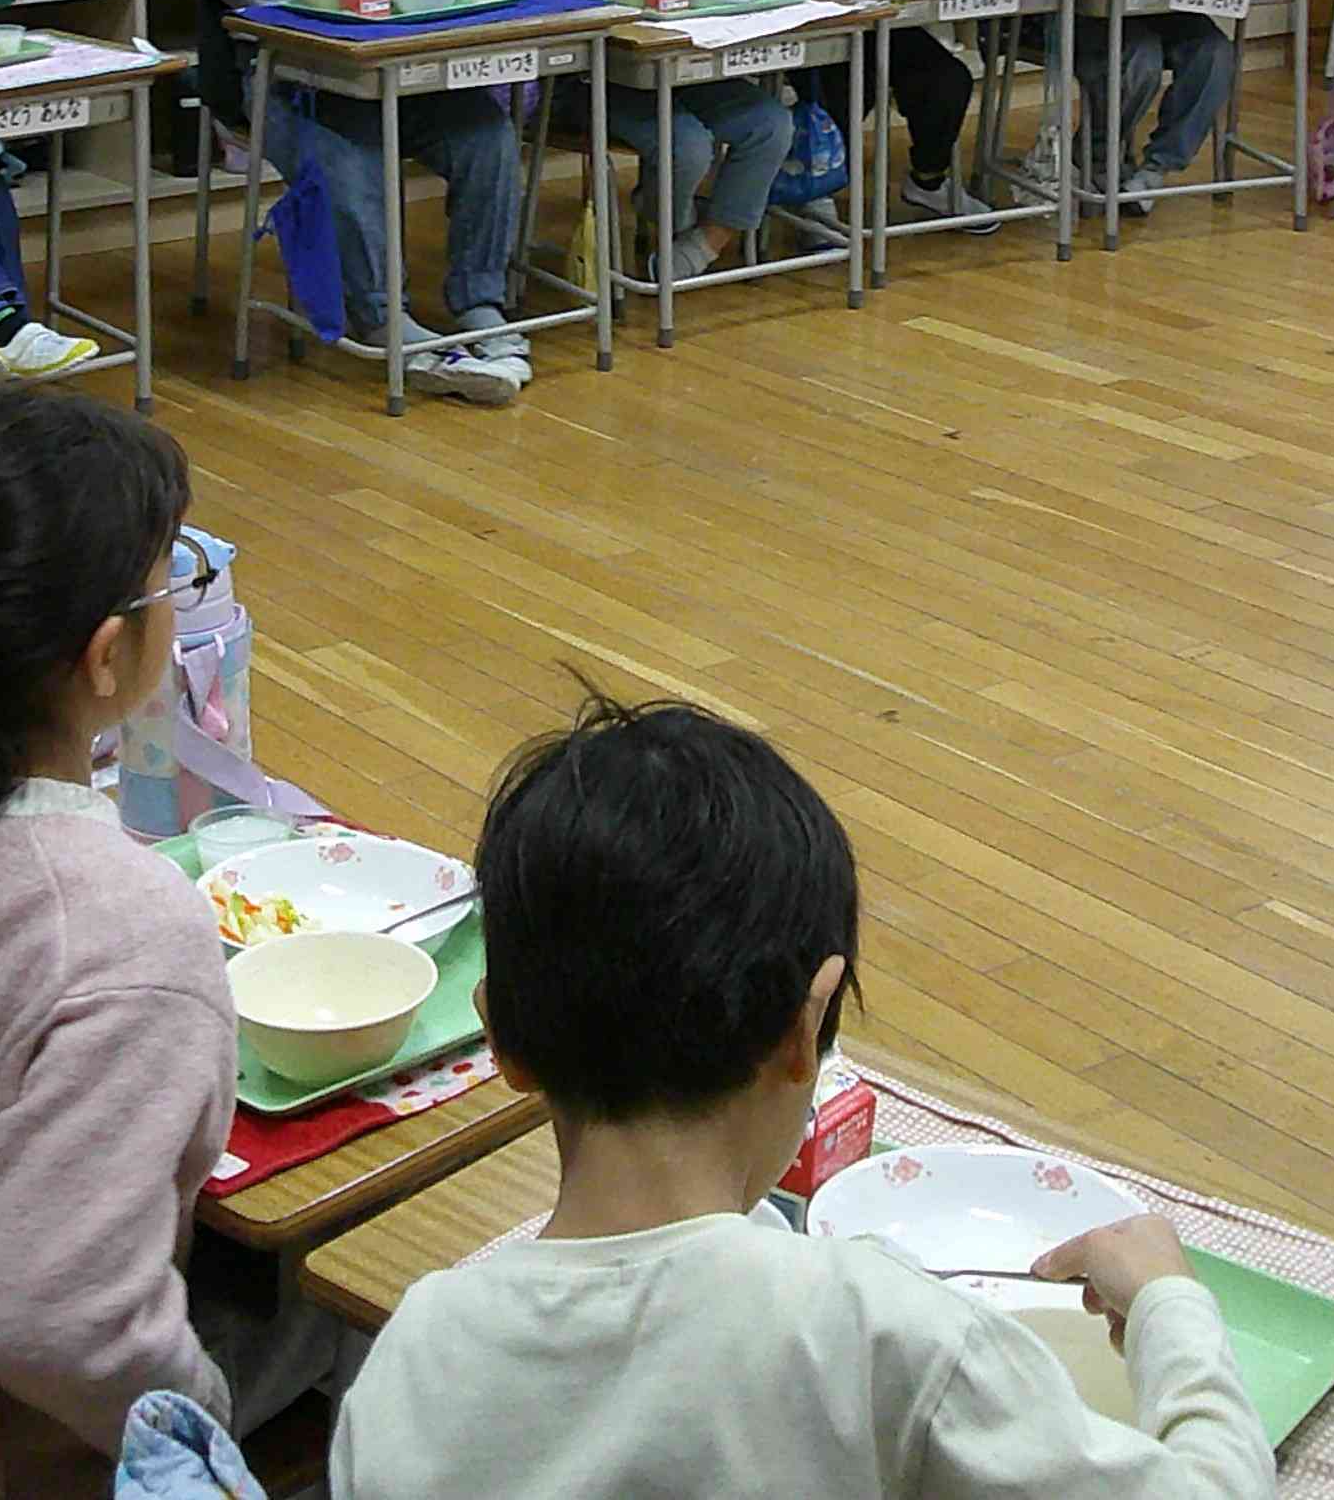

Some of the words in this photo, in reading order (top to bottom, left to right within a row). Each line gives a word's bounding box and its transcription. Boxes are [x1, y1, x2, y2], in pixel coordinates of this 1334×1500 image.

[498, 53, 533, 74] いつき
[40, 98, 81, 123] あんな
